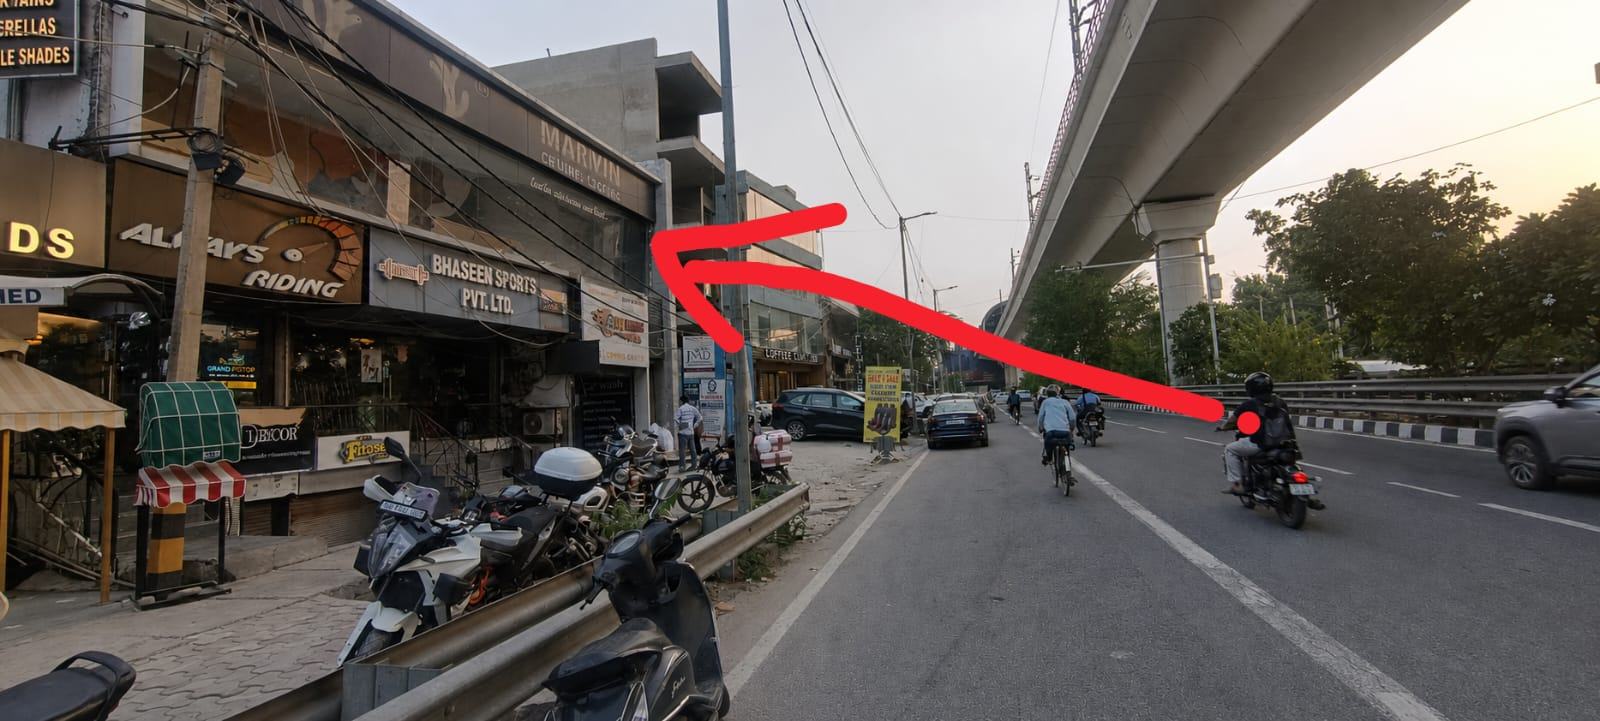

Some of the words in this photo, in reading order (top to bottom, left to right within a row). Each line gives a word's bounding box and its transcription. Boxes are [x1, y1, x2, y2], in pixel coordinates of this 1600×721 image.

[19, 46, 70, 65] SHADES
[540, 119, 621, 187] MARVIN
[242, 269, 345, 298] RIDING
[430, 253, 493, 286] BHASEEN
[494, 268, 537, 295] SPORTS
[461, 288, 489, 311] PVT.
[490, 293, 514, 315] LTD.
[207, 365, 231, 373] GRAND
[685, 349, 711, 363] JMD
